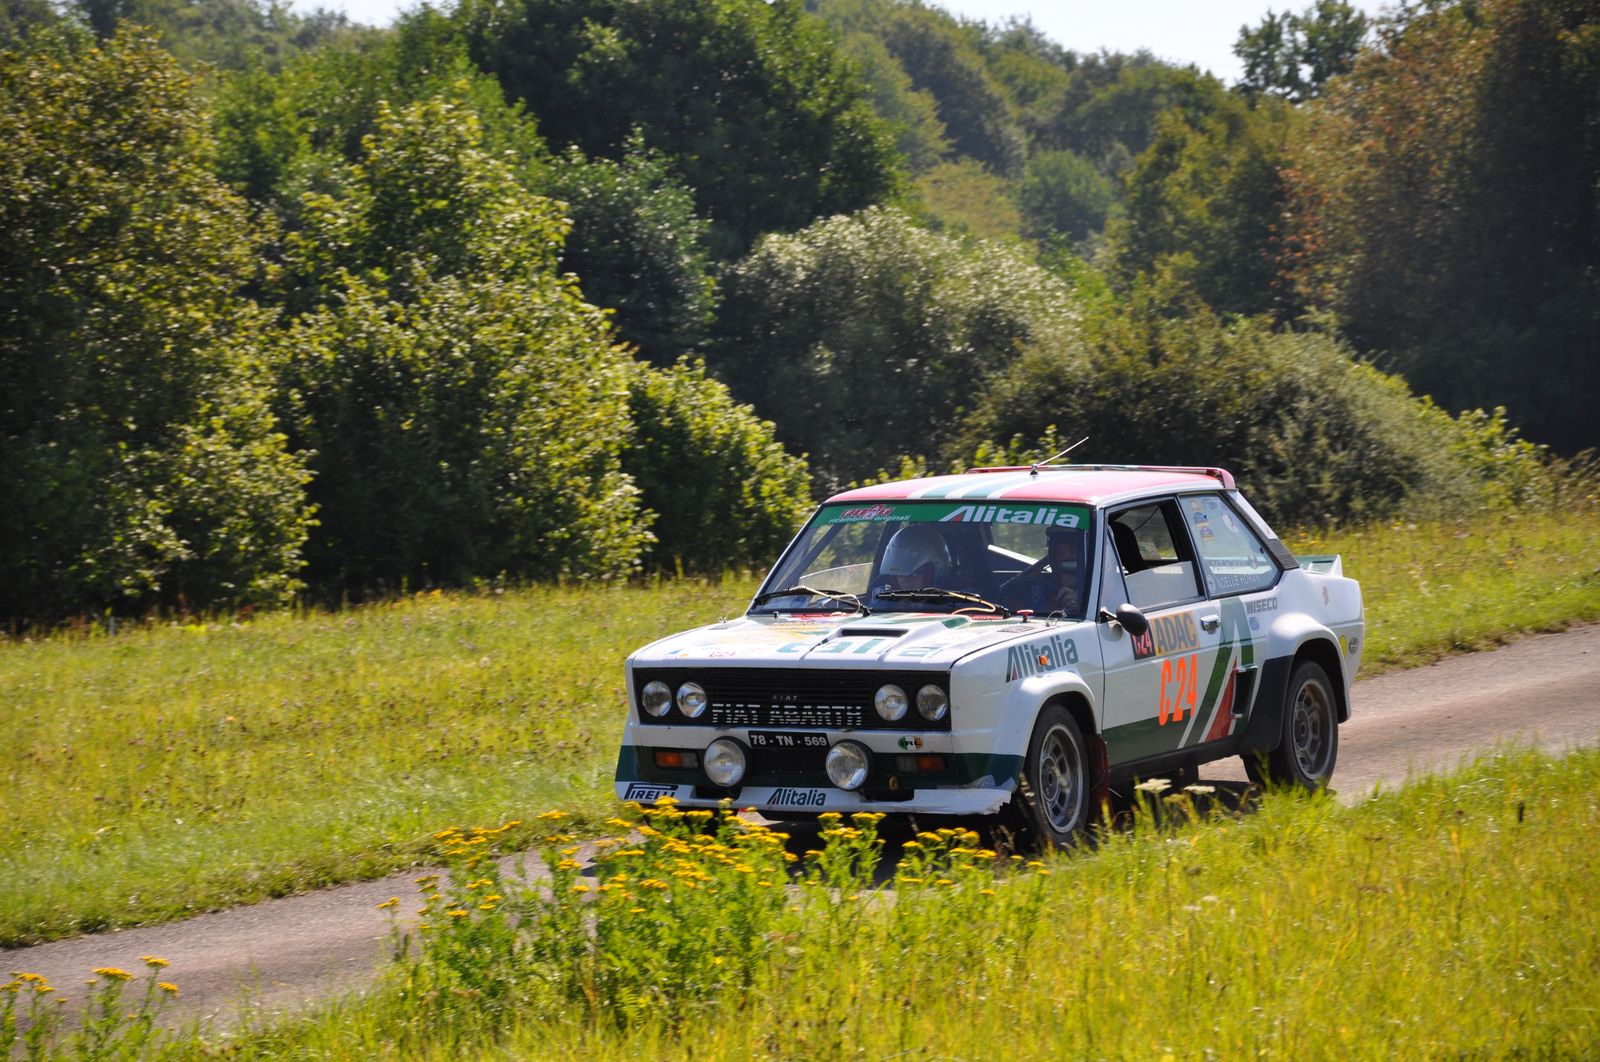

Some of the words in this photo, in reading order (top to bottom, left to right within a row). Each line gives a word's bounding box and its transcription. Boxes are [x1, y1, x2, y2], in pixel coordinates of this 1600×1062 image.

[939, 505, 1080, 528] Alitalia
[1246, 597, 1278, 614] WISECO
[1154, 613, 1197, 652] ADAC
[1006, 635, 1079, 683] Alitalia
[712, 703, 761, 724] FIAT
[768, 705, 862, 726] ABARTH
[751, 735, 767, 745] 78
[776, 736, 794, 746] TN
[804, 737, 827, 747] 569
[624, 783, 679, 800] PIRELLI
[767, 788, 827, 807] Alitalia
